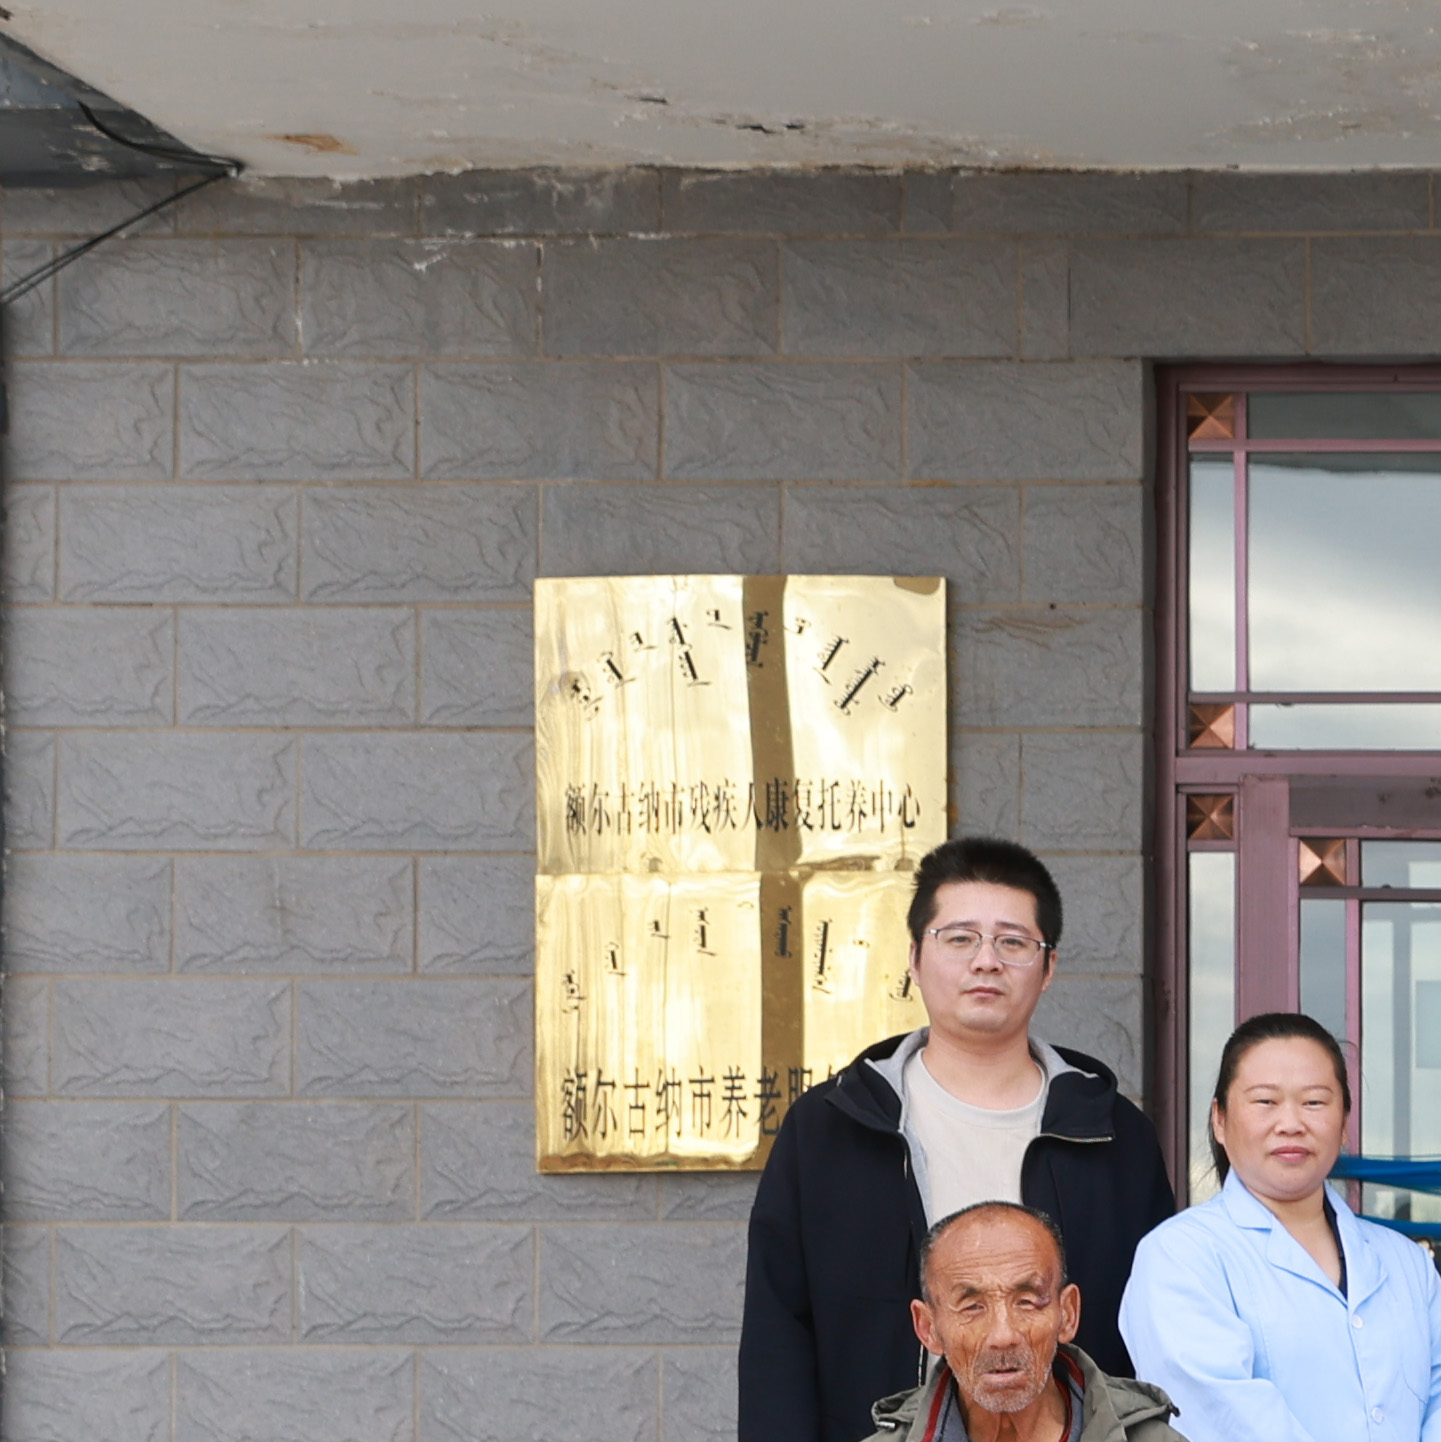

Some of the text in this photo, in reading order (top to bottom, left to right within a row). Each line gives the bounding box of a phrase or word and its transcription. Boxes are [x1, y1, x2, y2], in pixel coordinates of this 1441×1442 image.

[565, 777, 921, 836] 额尔古纳市残疾人康复托养中心
